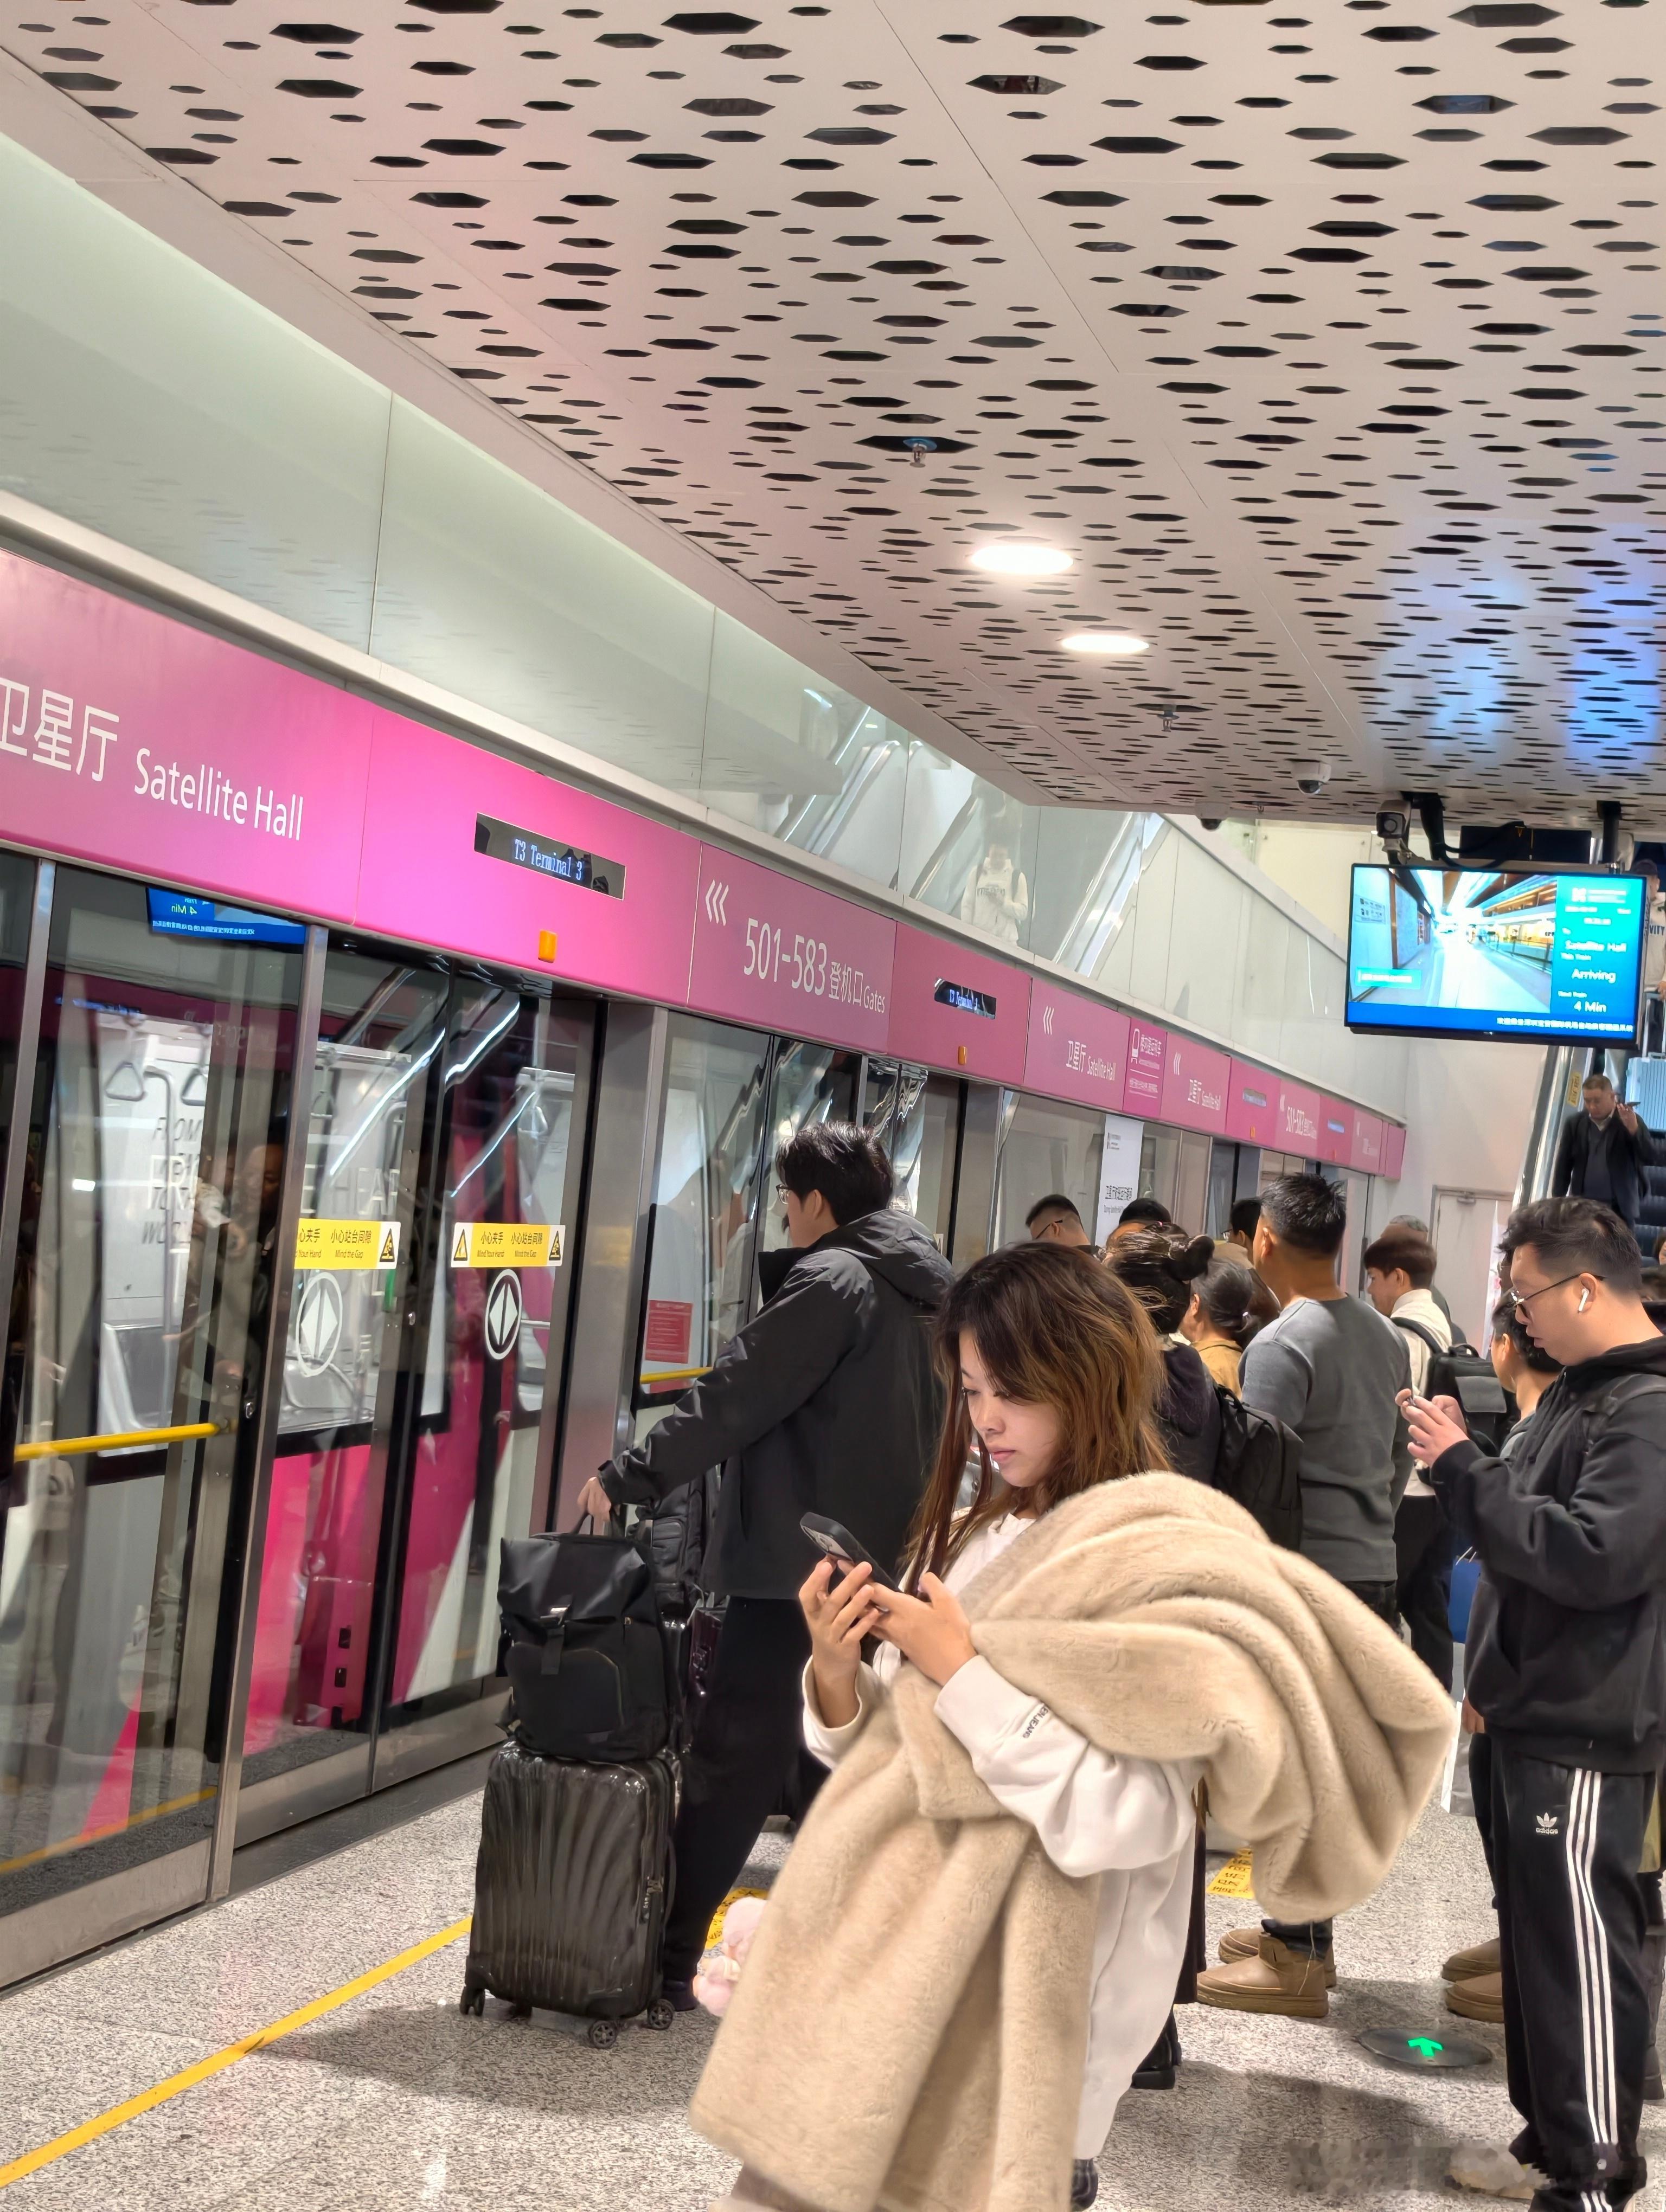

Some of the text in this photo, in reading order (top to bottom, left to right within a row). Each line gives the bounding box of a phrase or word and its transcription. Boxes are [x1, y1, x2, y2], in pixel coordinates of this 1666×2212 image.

[0, 677, 304, 841] 卫星厅 Satellite Hall
[515, 839, 582, 880] T3 Terminal 3
[744, 918, 885, 1013] 501-583 登机口 Gates
[1572, 968, 1616, 984] Arriving
[1574, 1001, 1607, 1013] 4 Min
[330, 1229, 372, 1244] 小心站台间隙
[480, 1231, 503, 1245] 小心夹手
[335, 1249, 347, 1258] Mind
[355, 1249, 364, 1260] Gap
